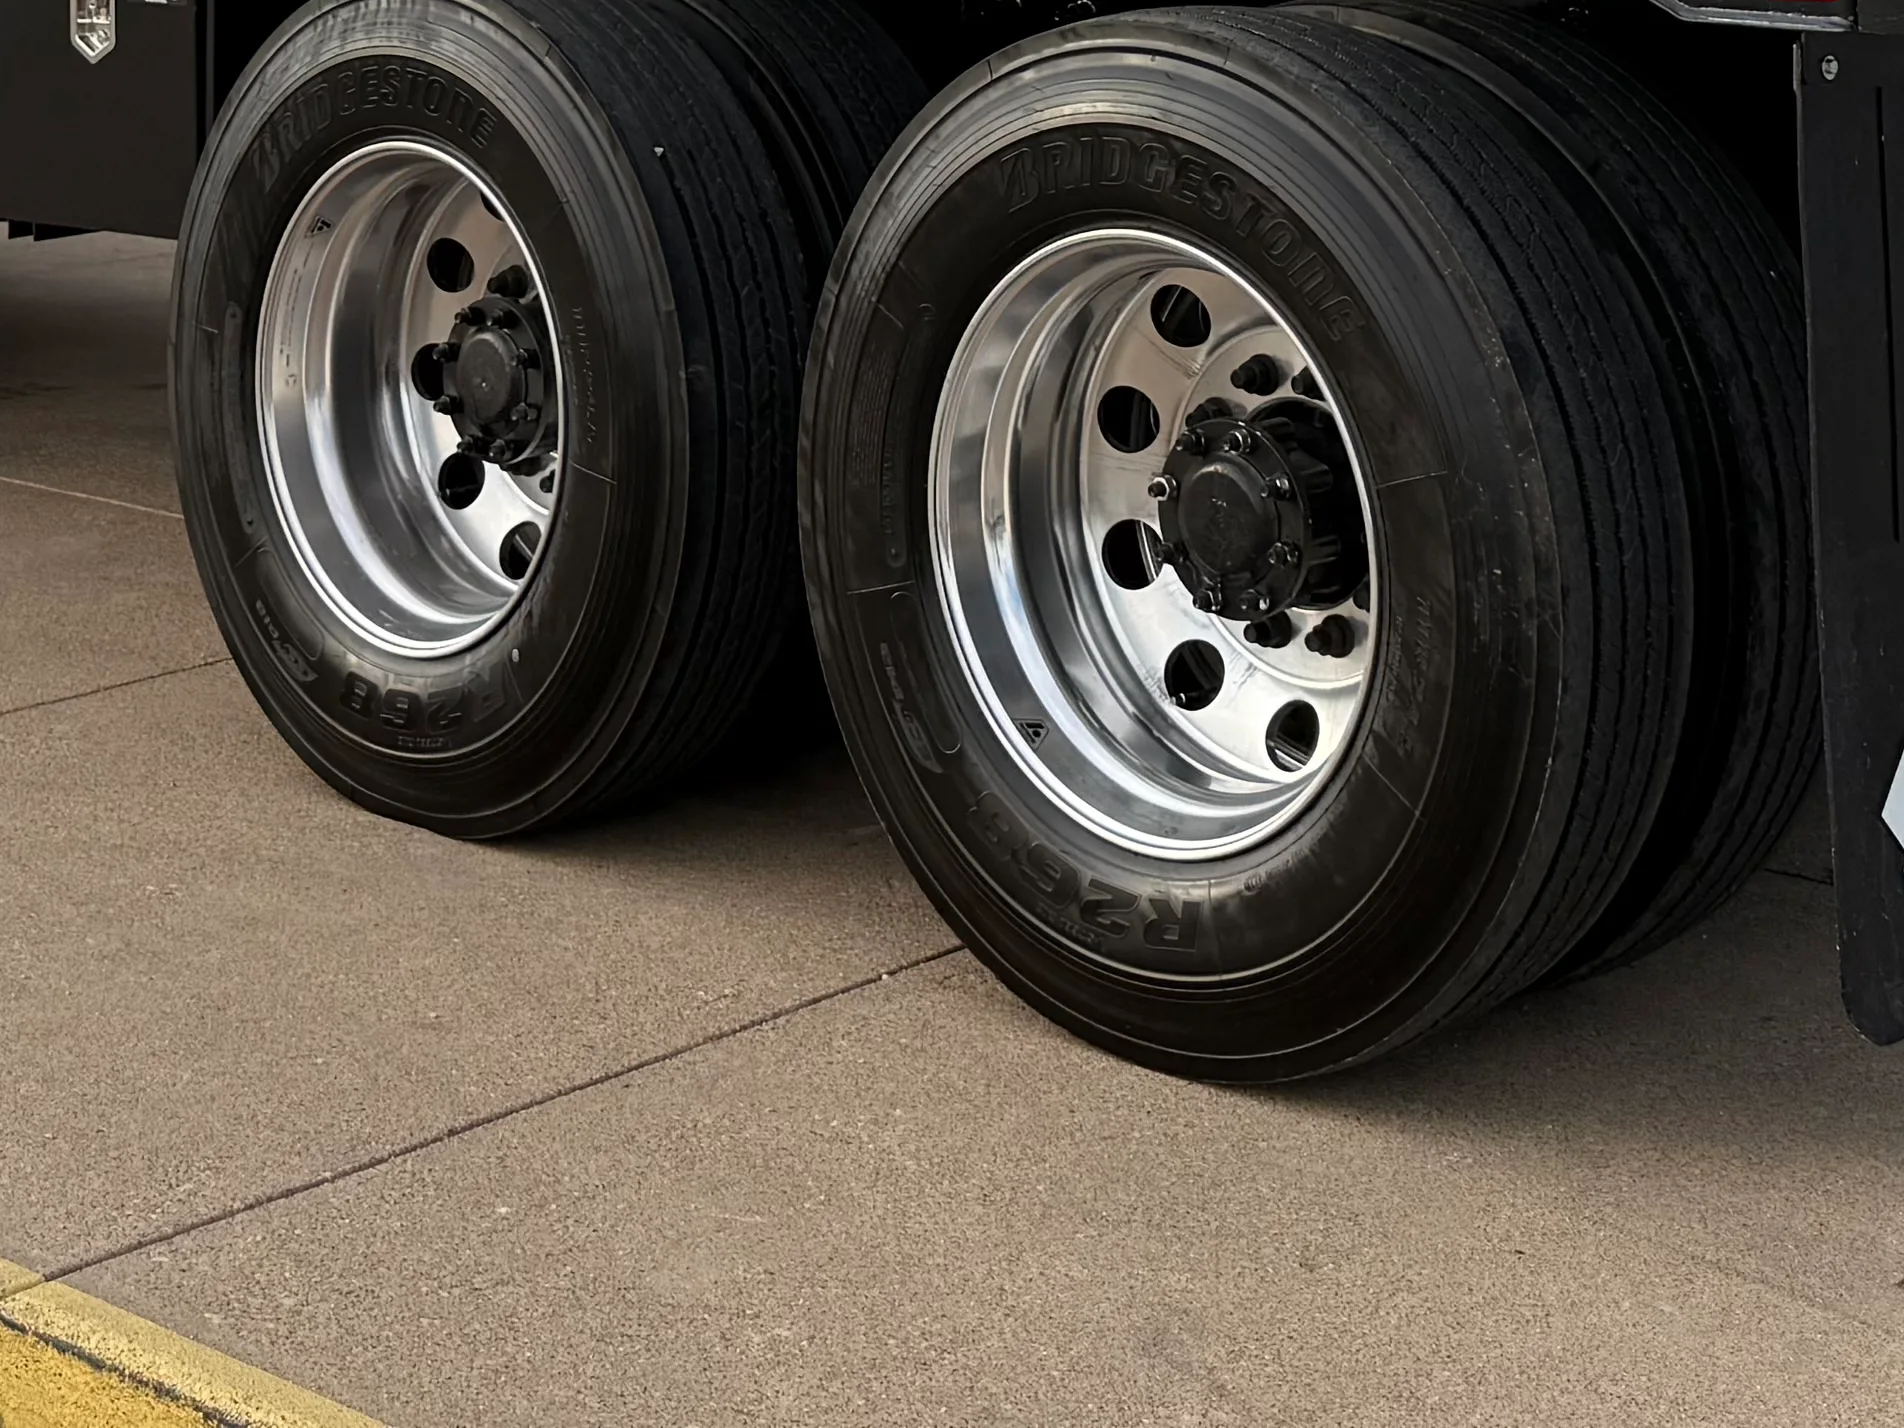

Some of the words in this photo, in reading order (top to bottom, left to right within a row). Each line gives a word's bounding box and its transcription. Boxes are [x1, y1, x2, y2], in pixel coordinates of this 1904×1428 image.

[252, 65, 497, 190] BRIDGESTONE
[1001, 136, 1366, 342] BRIDGESTONE
[968, 790, 1202, 952] R268
